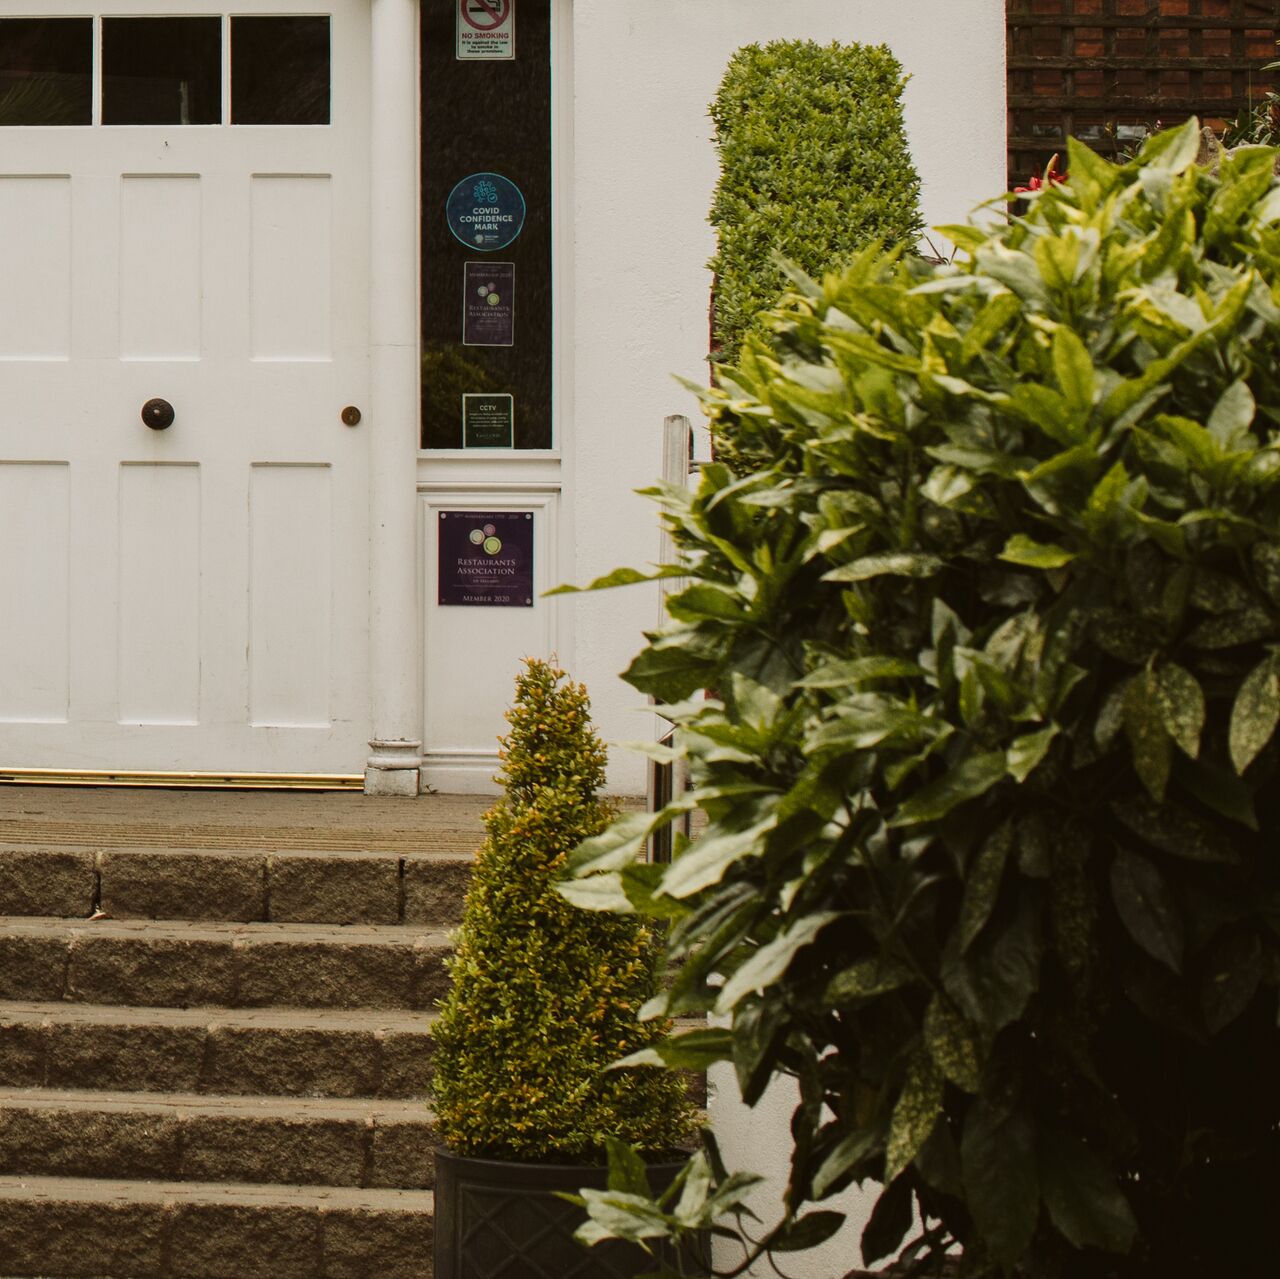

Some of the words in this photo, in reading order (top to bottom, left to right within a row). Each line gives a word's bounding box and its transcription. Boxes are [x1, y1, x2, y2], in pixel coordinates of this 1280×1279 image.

[473, 207, 500, 215] COVID
[460, 215, 513, 223] CONFIDENCE
[475, 223, 499, 231] MARK
[457, 558, 516, 566] RESTAURANTS
